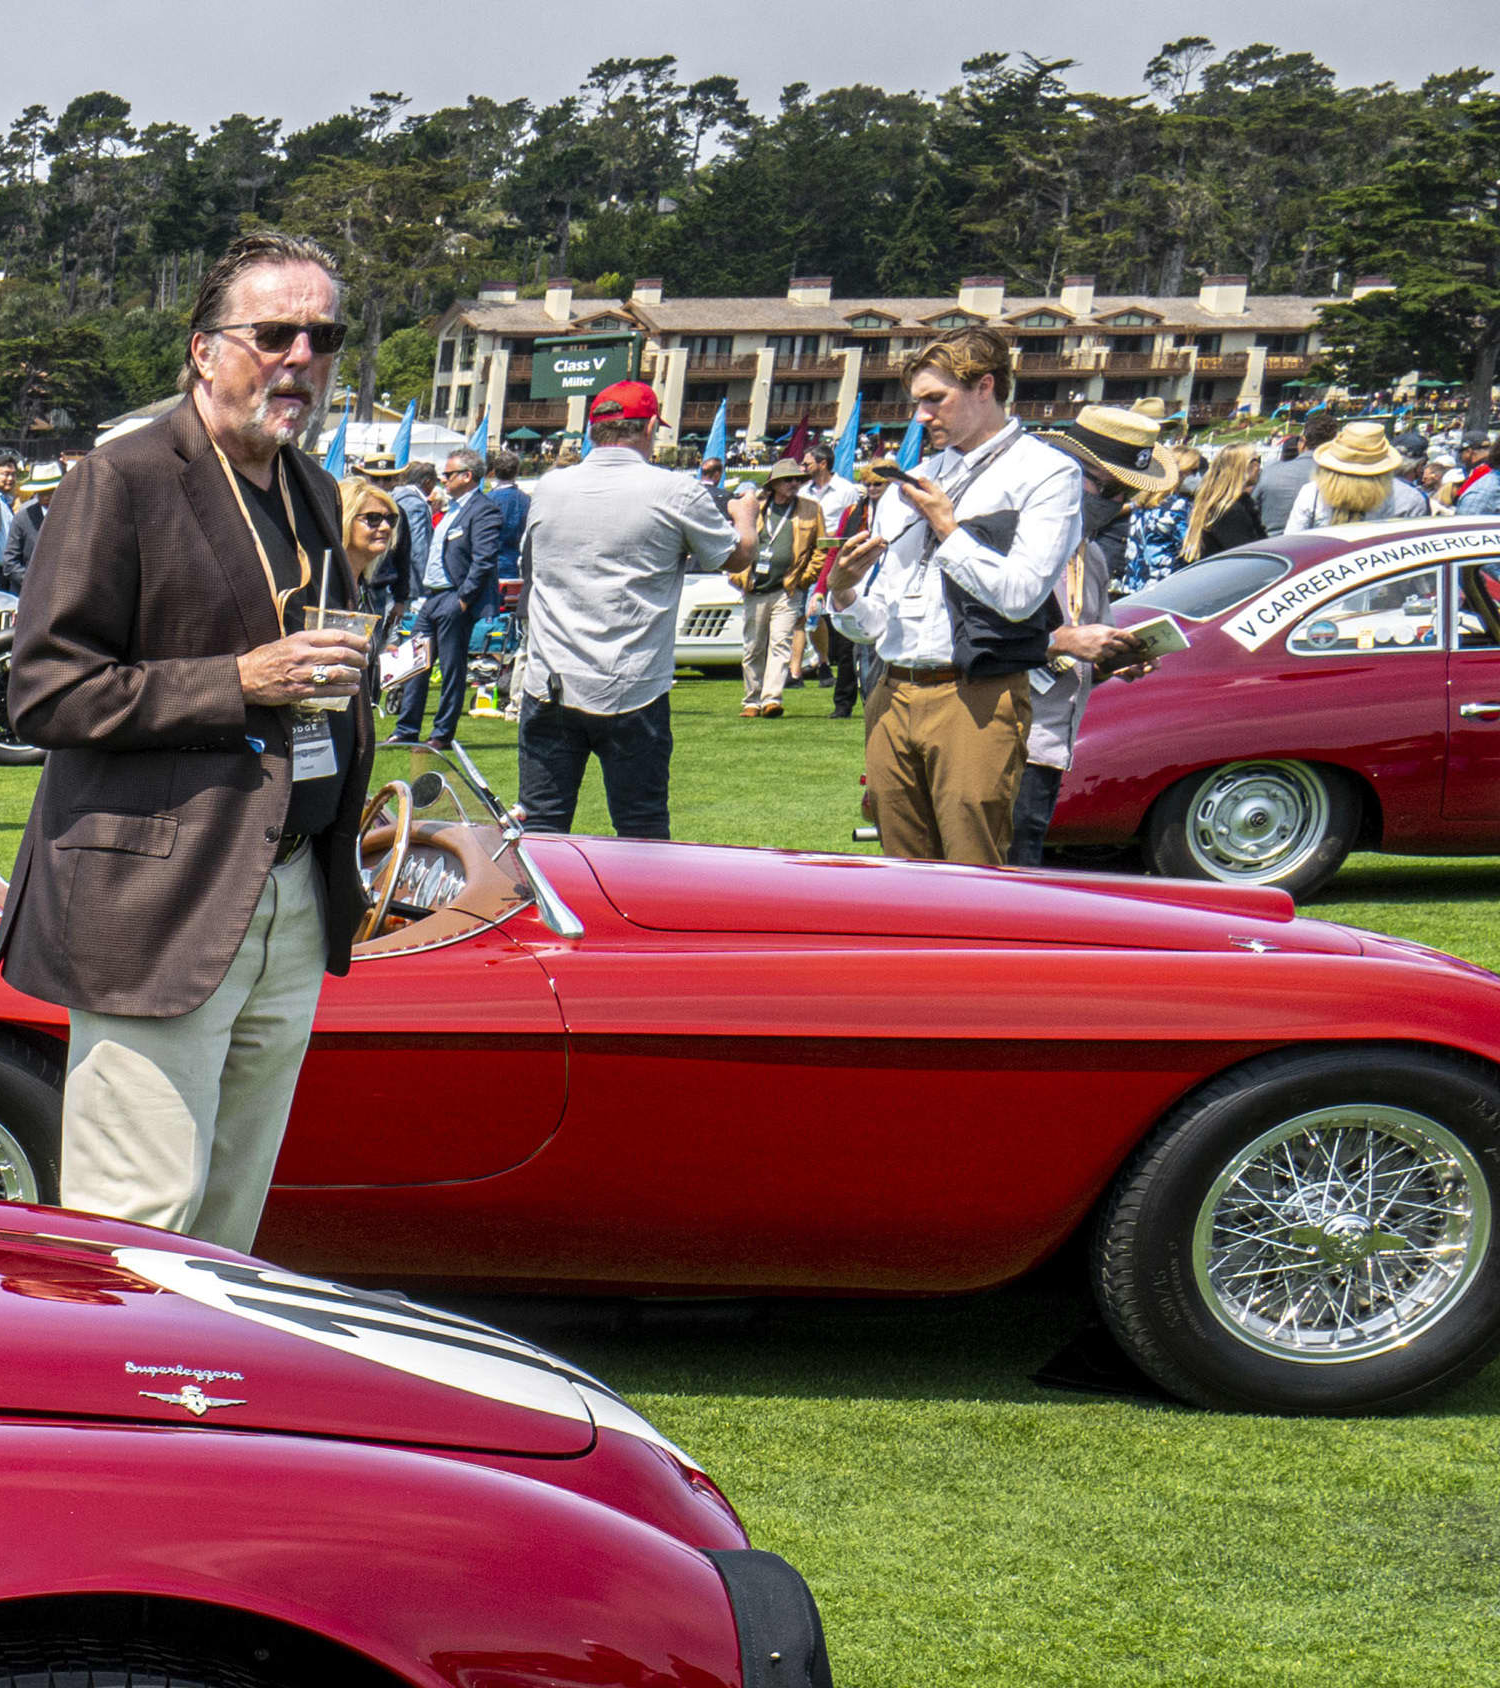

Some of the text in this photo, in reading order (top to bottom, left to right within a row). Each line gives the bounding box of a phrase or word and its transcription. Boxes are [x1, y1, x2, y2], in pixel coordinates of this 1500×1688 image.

[553, 356, 606, 373] Class V
[561, 375, 595, 388] Miller
[1237, 619, 1258, 638] V
[1256, 562, 1357, 626] CARRERA
[124, 1360, 244, 1383] Superleggera
